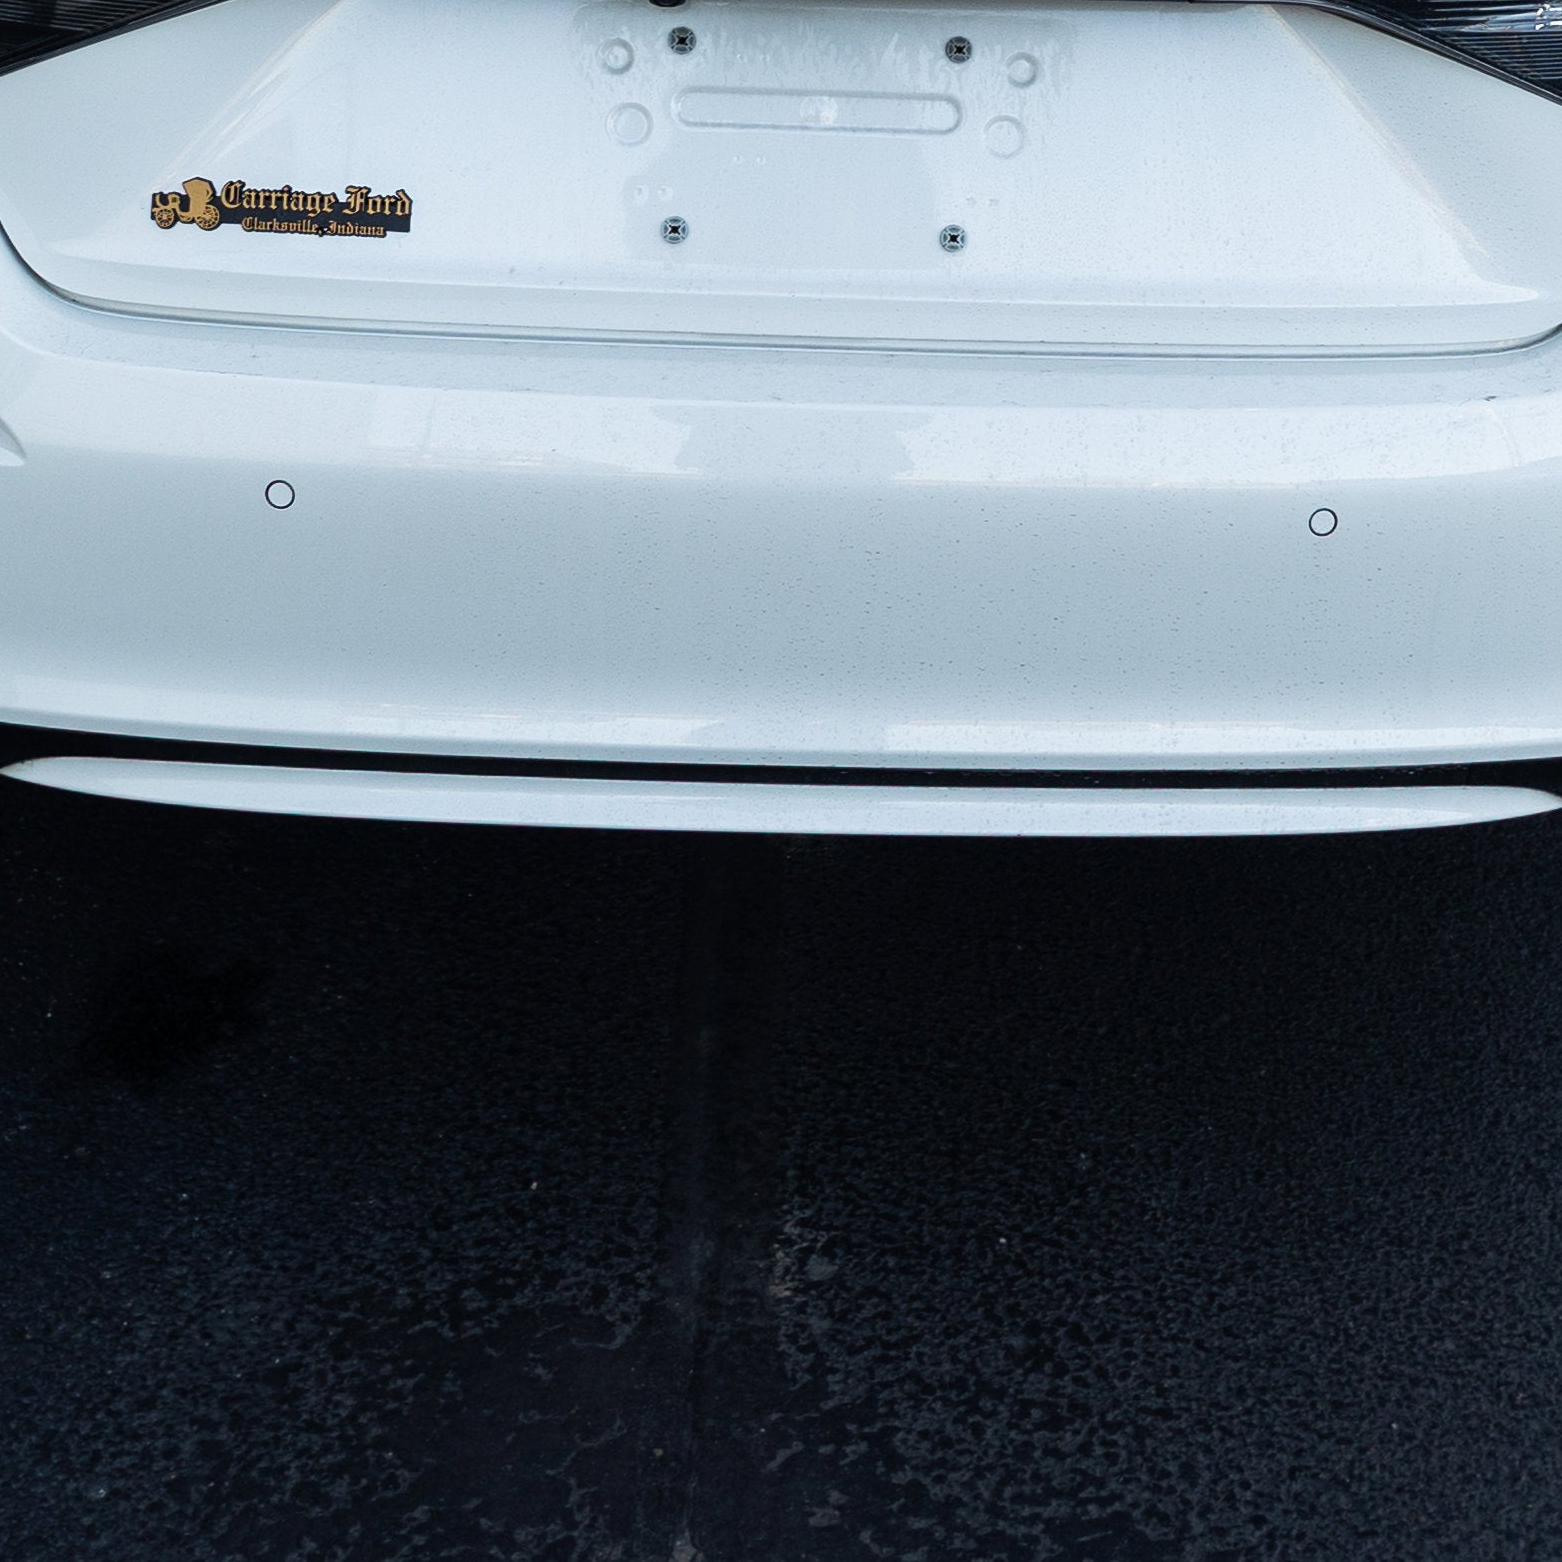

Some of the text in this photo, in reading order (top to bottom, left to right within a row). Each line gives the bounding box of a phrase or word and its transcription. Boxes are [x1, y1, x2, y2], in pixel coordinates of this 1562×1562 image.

[221, 181, 410, 217] Carriage Ford
[242, 217, 384, 236] Clarksville, Indiana
